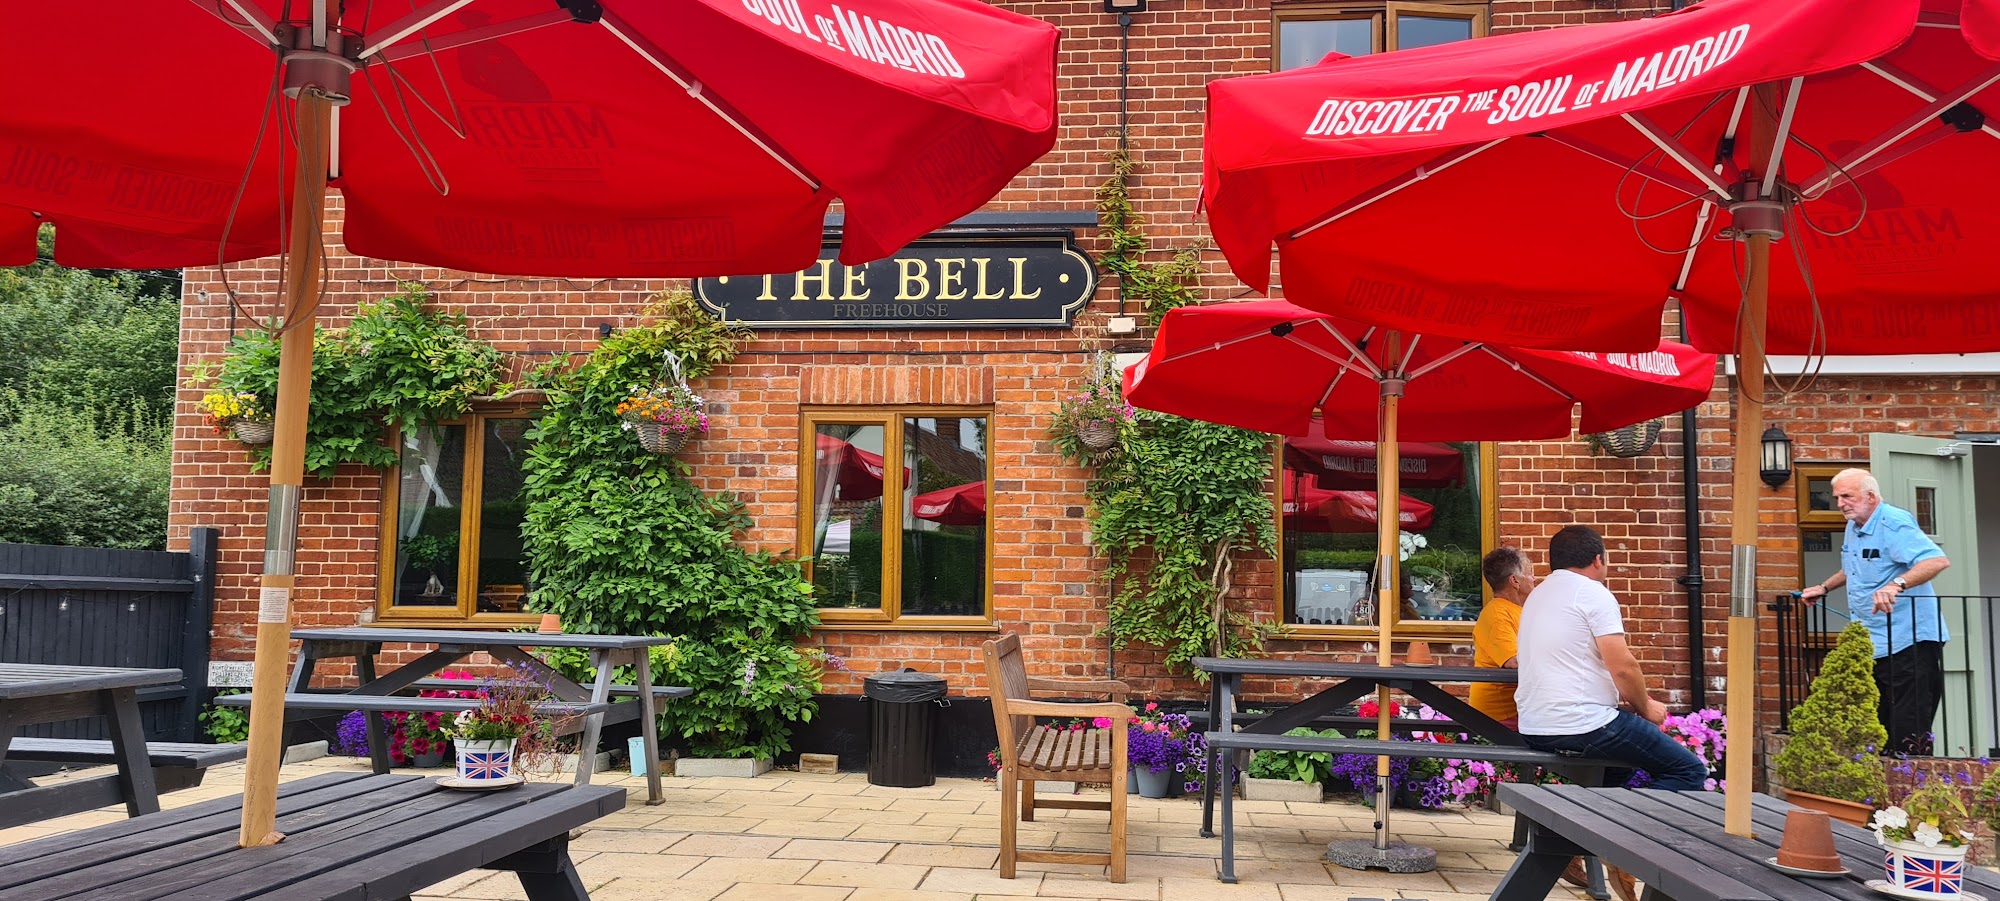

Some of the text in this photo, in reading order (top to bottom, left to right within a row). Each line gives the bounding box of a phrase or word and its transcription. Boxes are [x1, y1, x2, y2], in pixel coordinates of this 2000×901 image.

[815, 15, 846, 51] OF
[832, 4, 965, 78] MADRID
[1306, 23, 1750, 136] DISCOVER THE SOUL OF MADRID
[894, 257, 1042, 300] BELL
[832, 303, 949, 319] FREEHOUSE
[1638, 351, 1680, 376] MADRID
